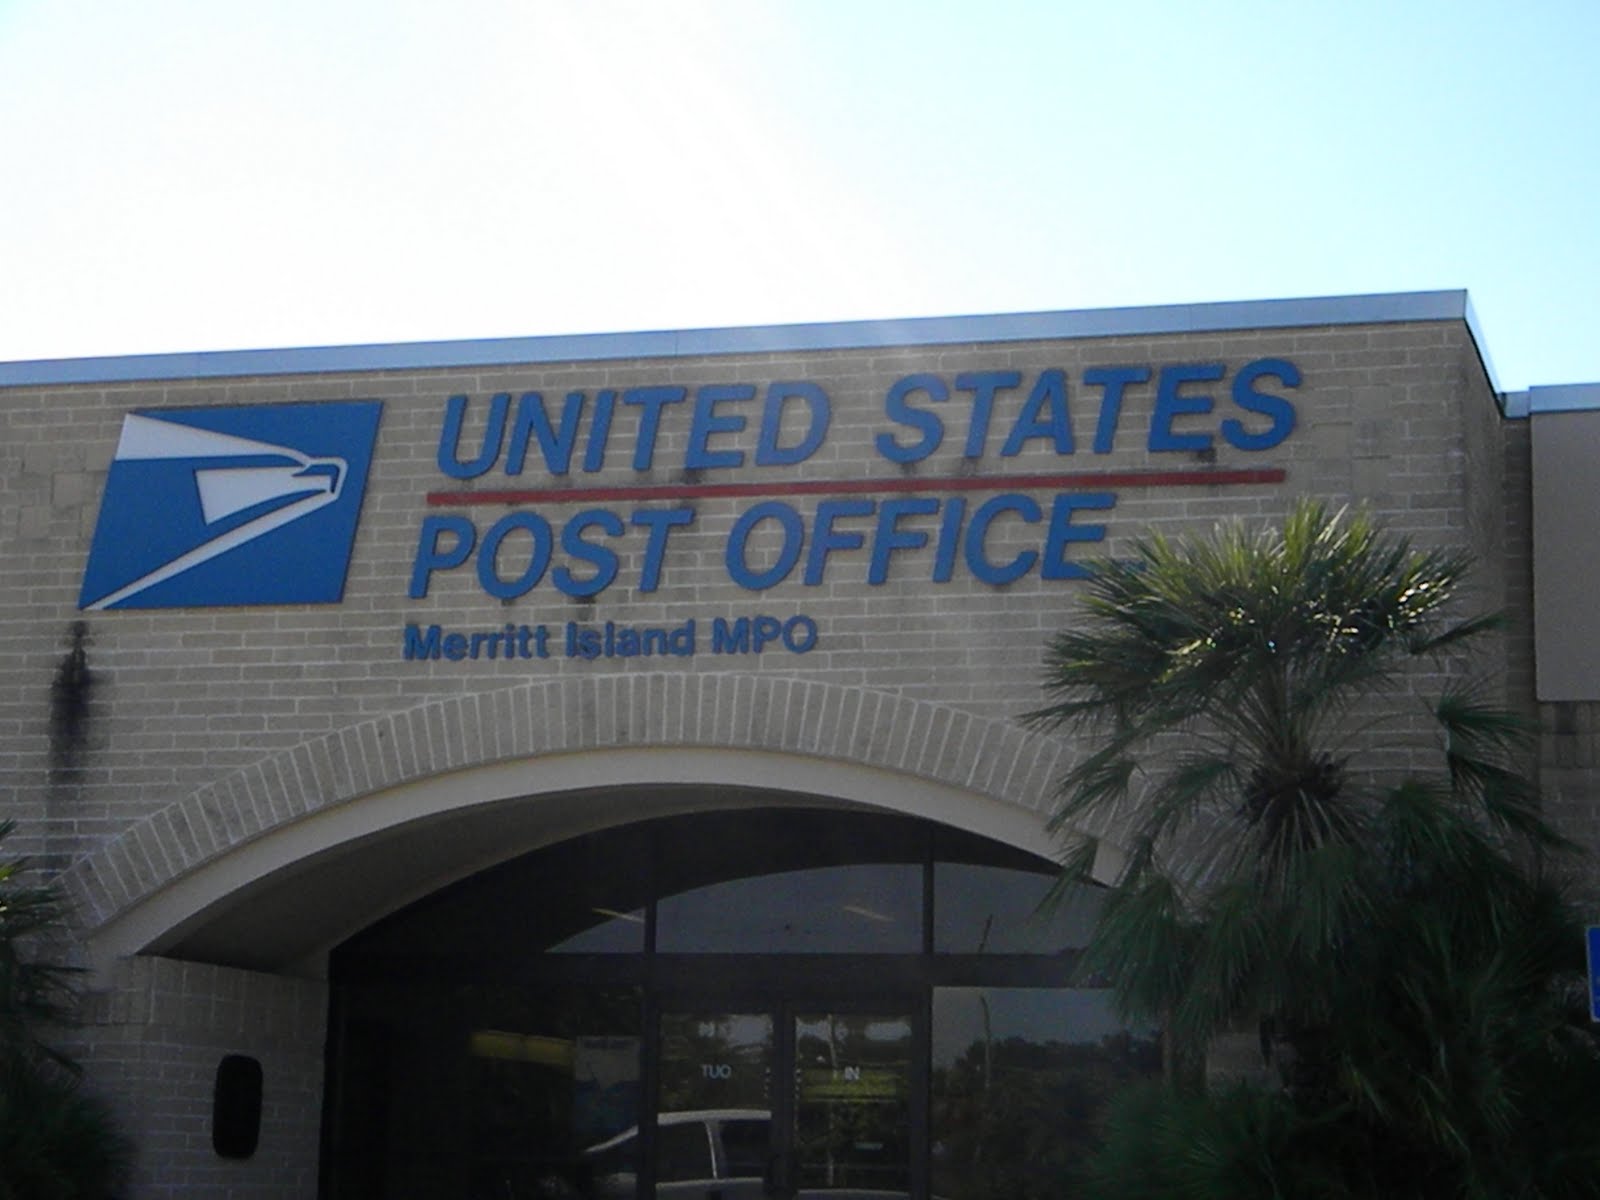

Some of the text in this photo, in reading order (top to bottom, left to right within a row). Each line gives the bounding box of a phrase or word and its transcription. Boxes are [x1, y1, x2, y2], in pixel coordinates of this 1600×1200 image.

[437, 358, 1301, 479] UNITED STATES
[408, 492, 1117, 599] POST OFFICE
[403, 615, 818, 661] Merritt Island MPO
